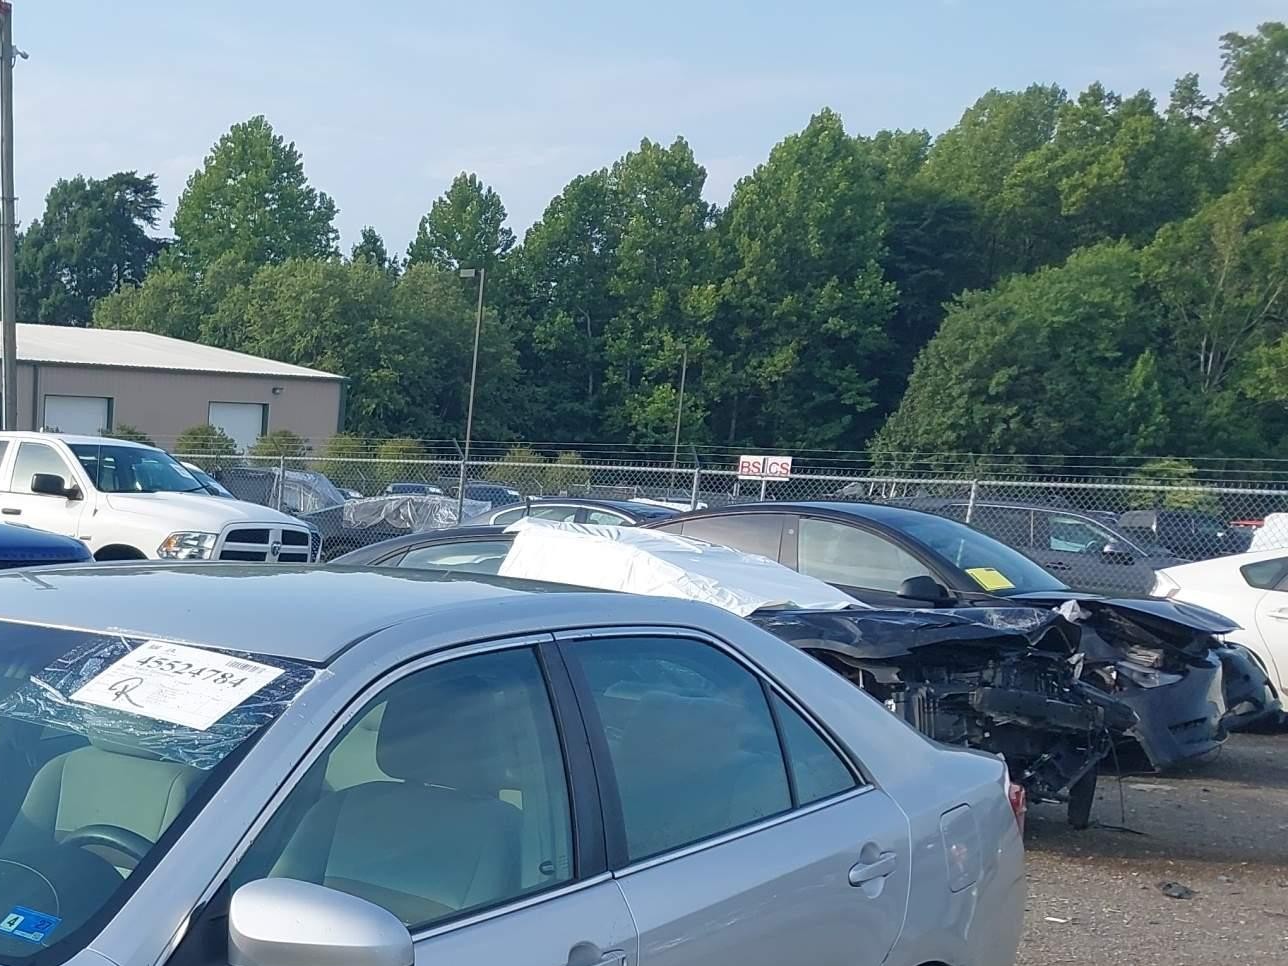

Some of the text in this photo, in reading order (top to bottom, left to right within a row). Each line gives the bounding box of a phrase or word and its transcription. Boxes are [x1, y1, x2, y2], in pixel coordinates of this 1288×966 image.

[741, 460, 761, 474] BS
[768, 462, 790, 475] CS
[136, 655, 248, 688] 45524784
[7, 916, 20, 928] 4
